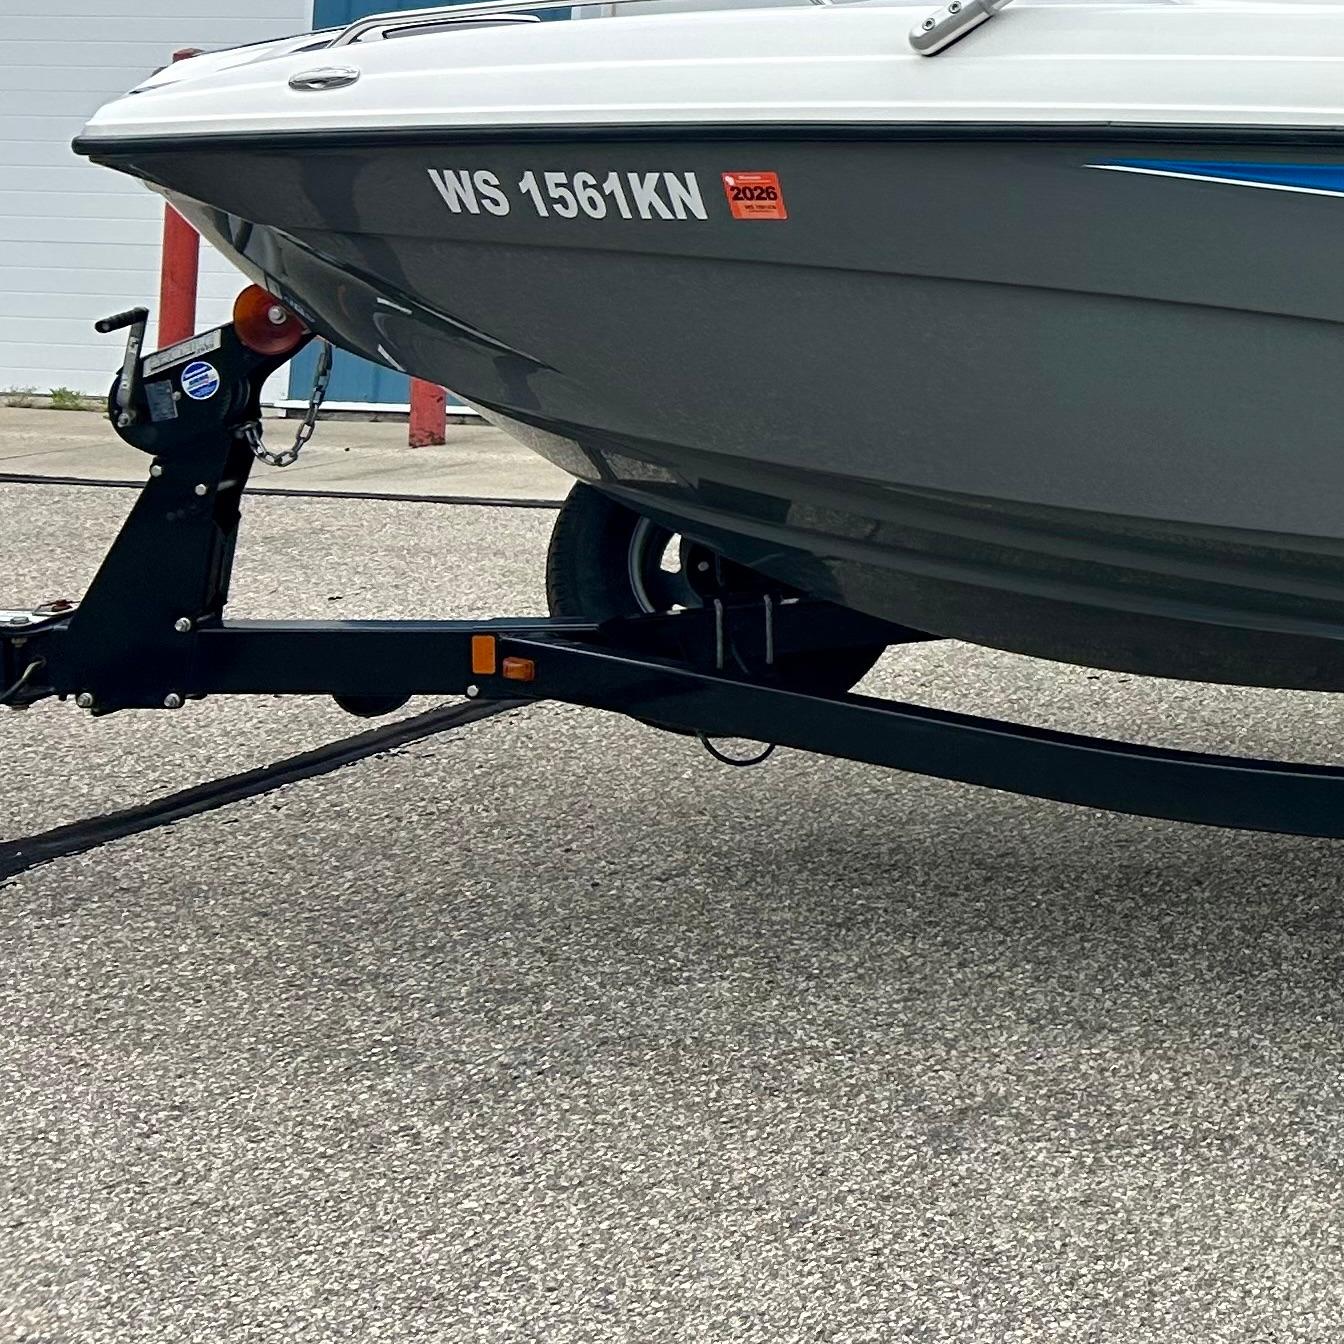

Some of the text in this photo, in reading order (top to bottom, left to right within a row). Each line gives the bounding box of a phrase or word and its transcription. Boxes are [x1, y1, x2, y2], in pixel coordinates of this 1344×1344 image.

[427, 169, 708, 221] WS 1561KN
[730, 185, 777, 200] 2026
